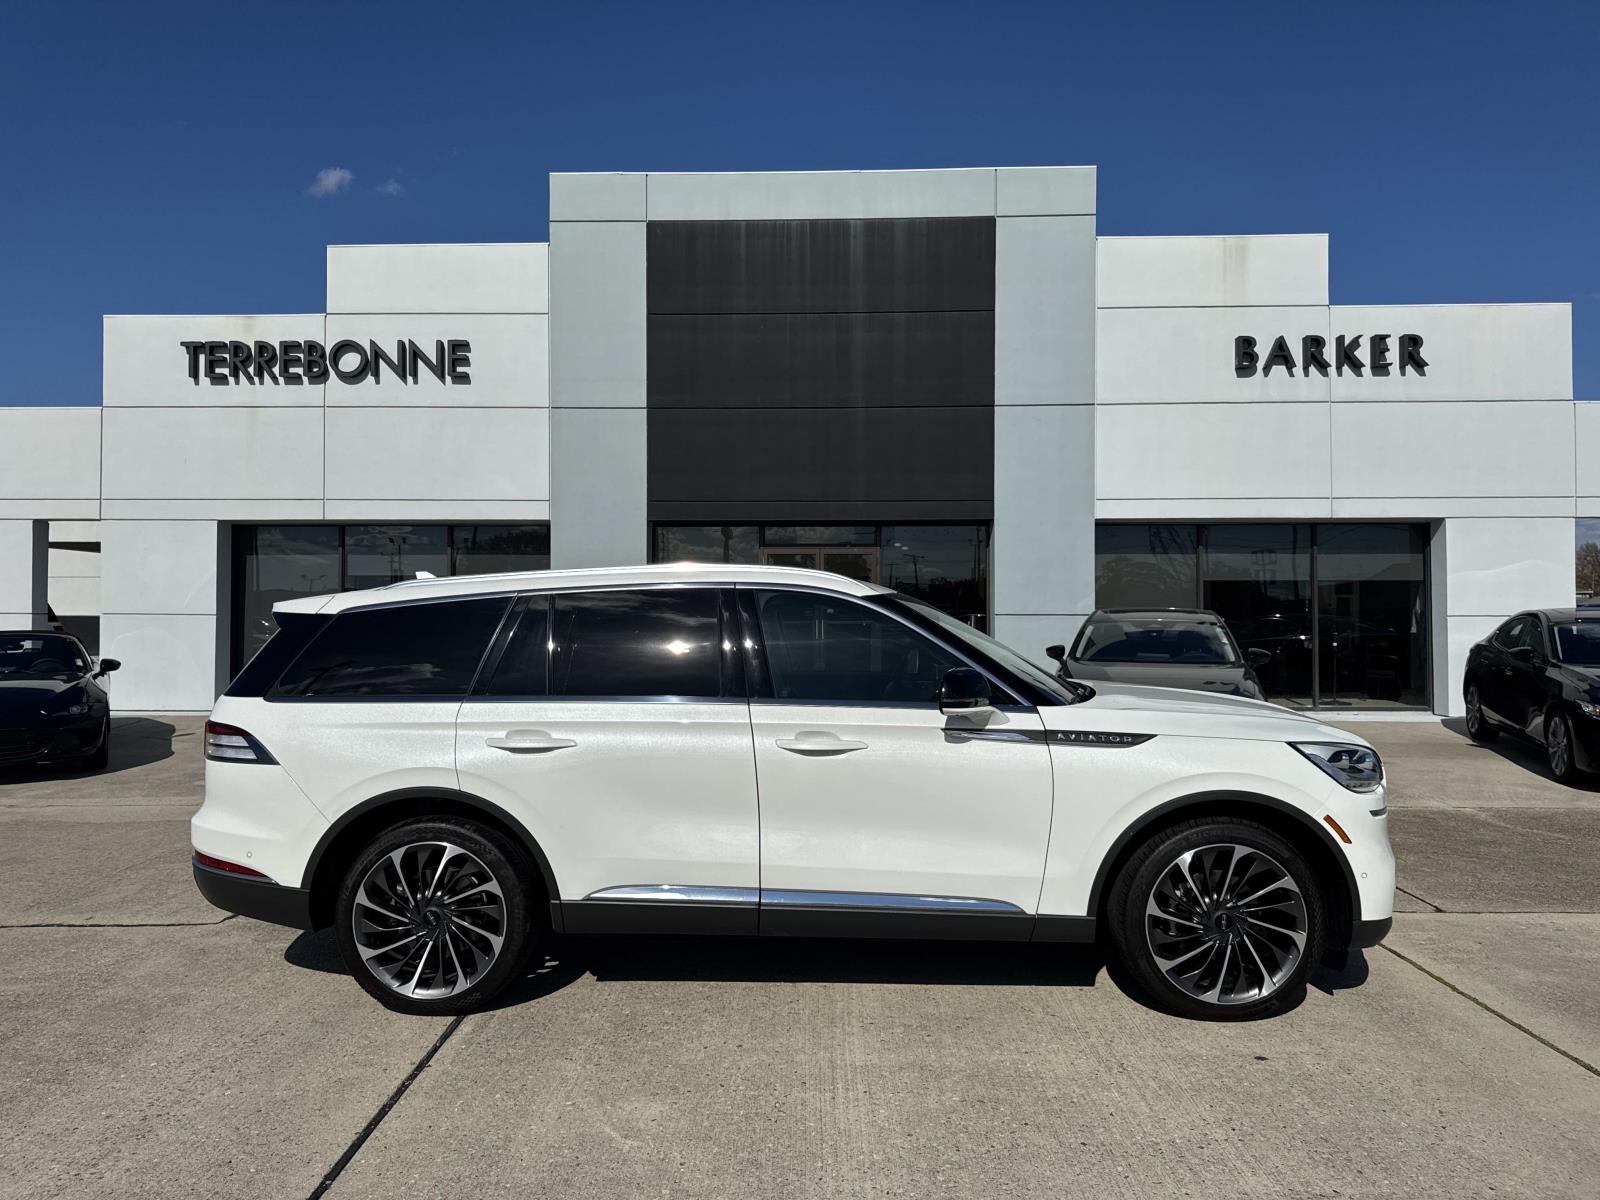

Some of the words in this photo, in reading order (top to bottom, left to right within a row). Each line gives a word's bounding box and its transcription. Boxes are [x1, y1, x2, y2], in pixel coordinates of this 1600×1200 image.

[180, 338, 472, 385] TERREBONNE
[1235, 333, 1430, 378] BARKER
[1057, 733, 1132, 743] AVIATOR
